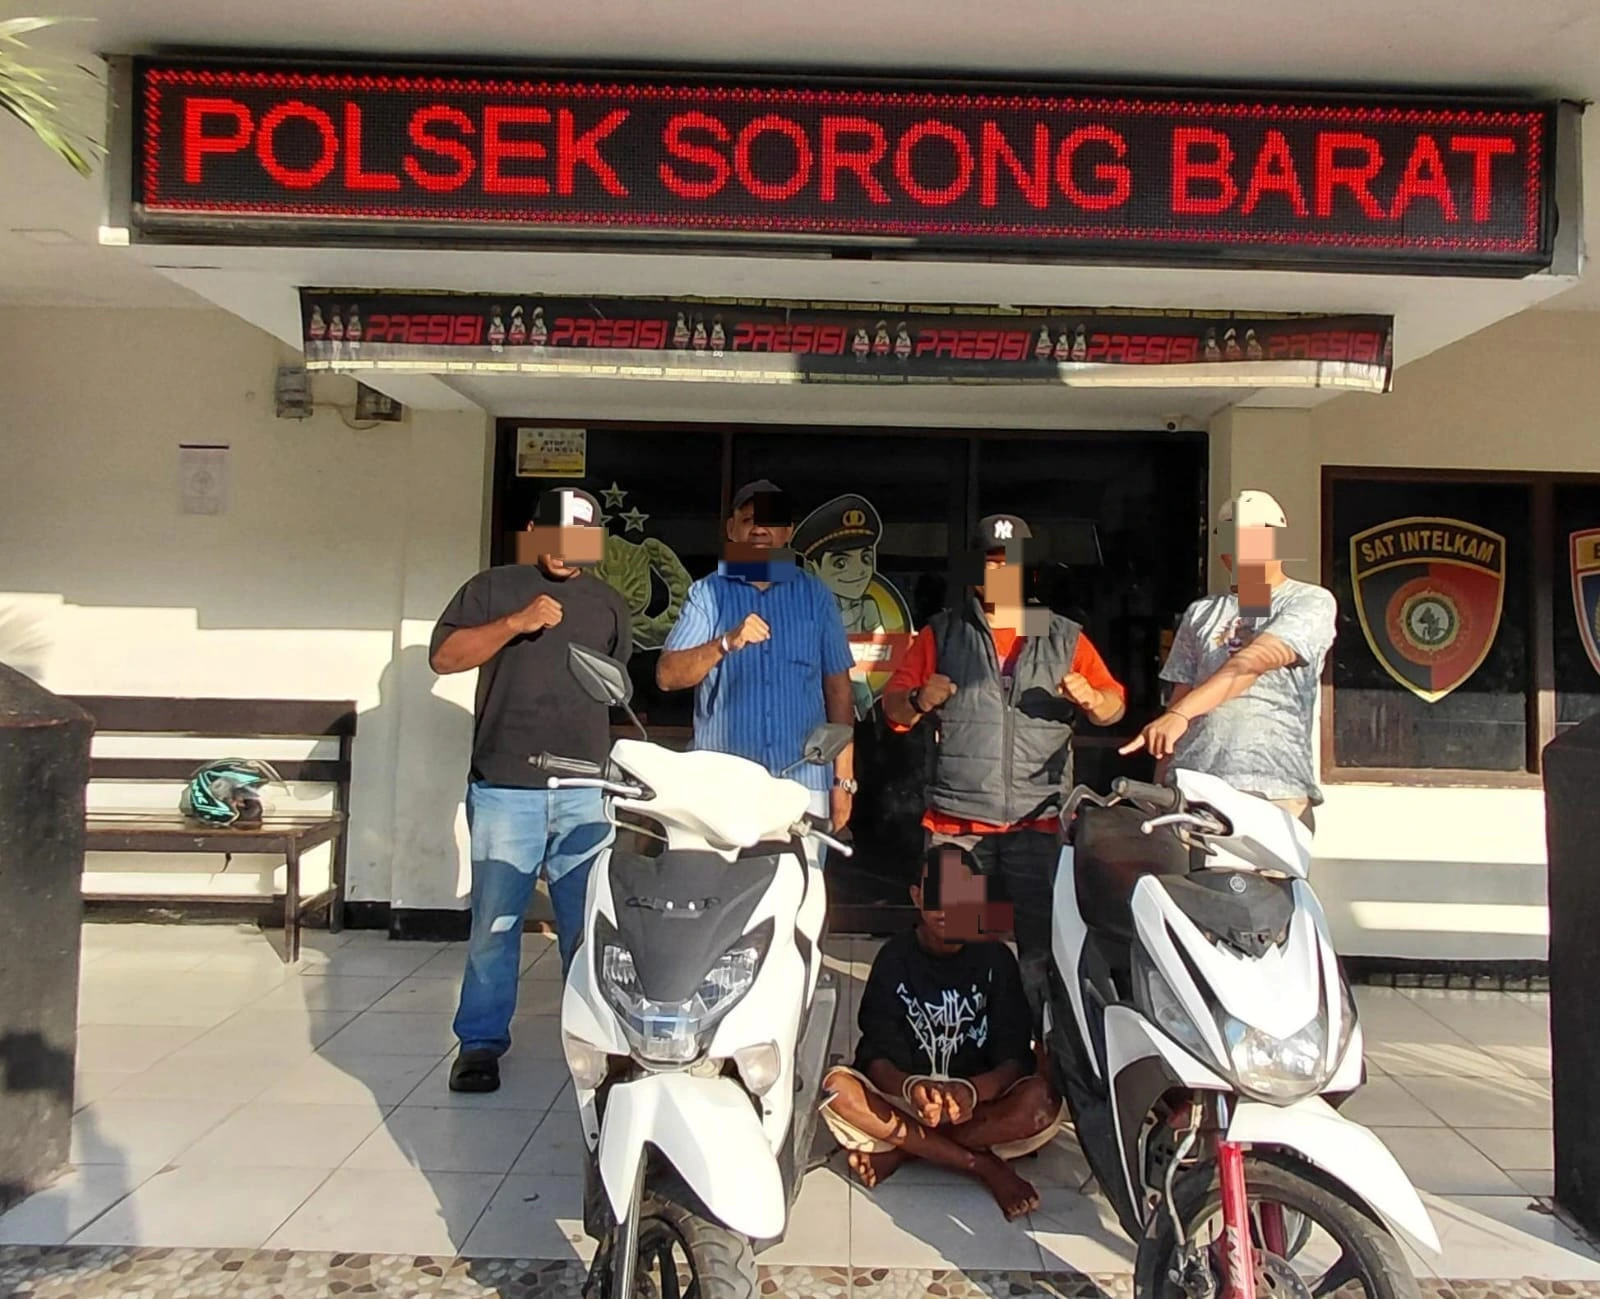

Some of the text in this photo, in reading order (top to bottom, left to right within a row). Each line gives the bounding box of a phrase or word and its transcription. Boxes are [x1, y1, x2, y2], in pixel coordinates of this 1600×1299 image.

[184, 97, 1515, 222] POLSEK SORONG BARAT
[366, 314, 1382, 364] PRESISI PRESISI PRESISI PRESISI PRESISI PRESISI
[1362, 531, 1494, 563] SAT INTELKAM
